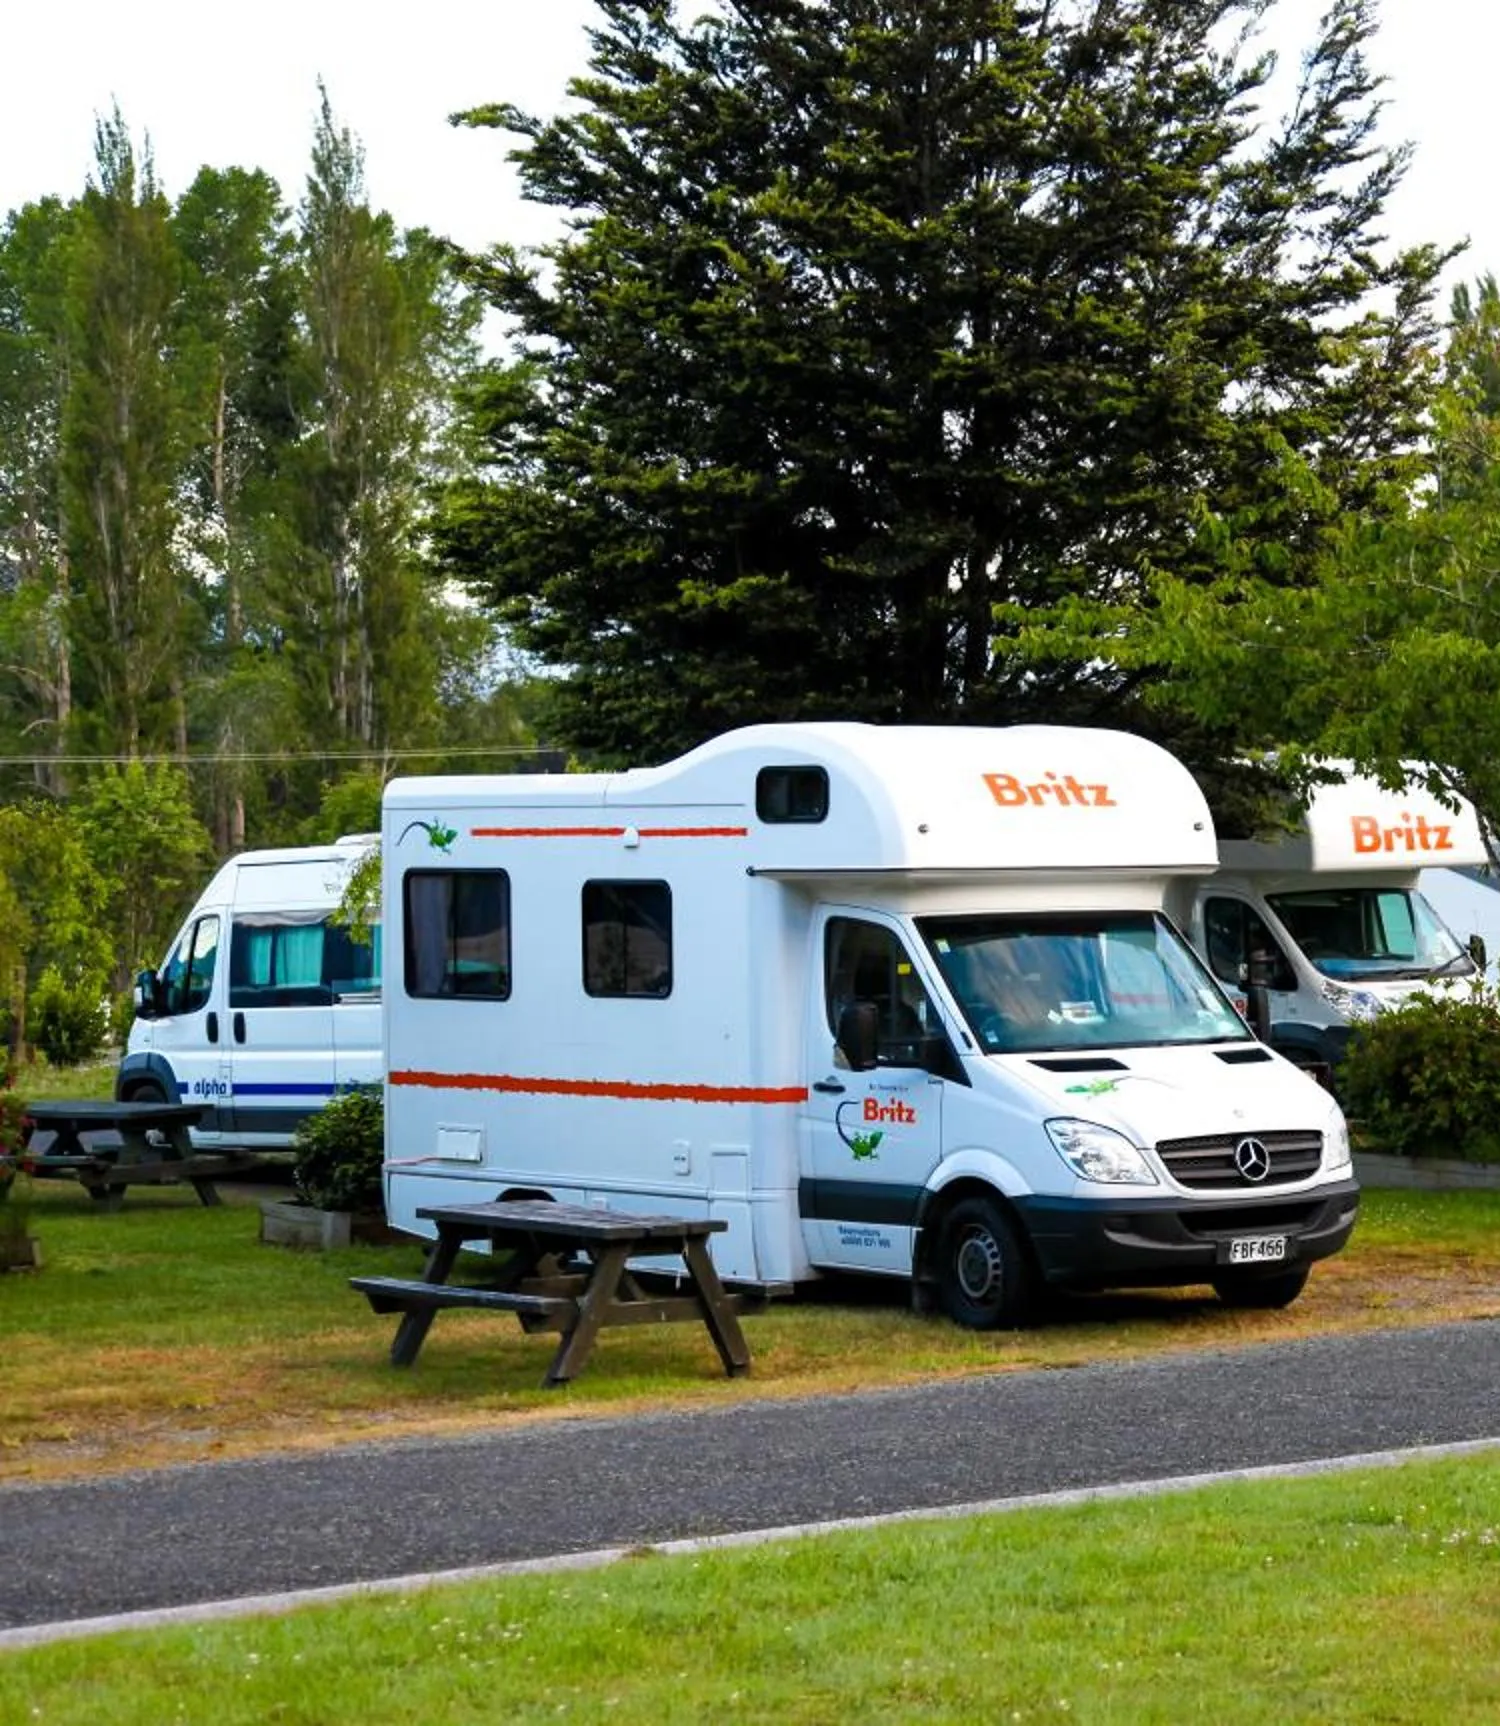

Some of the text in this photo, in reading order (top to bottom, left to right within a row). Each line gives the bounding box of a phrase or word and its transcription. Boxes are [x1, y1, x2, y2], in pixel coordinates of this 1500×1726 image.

[981, 771, 1117, 806] Britz
[1350, 812, 1453, 853] Britz
[193, 1078, 227, 1099] alpha
[864, 1097, 916, 1123] Britz
[1233, 1240, 1283, 1259] FBF466
